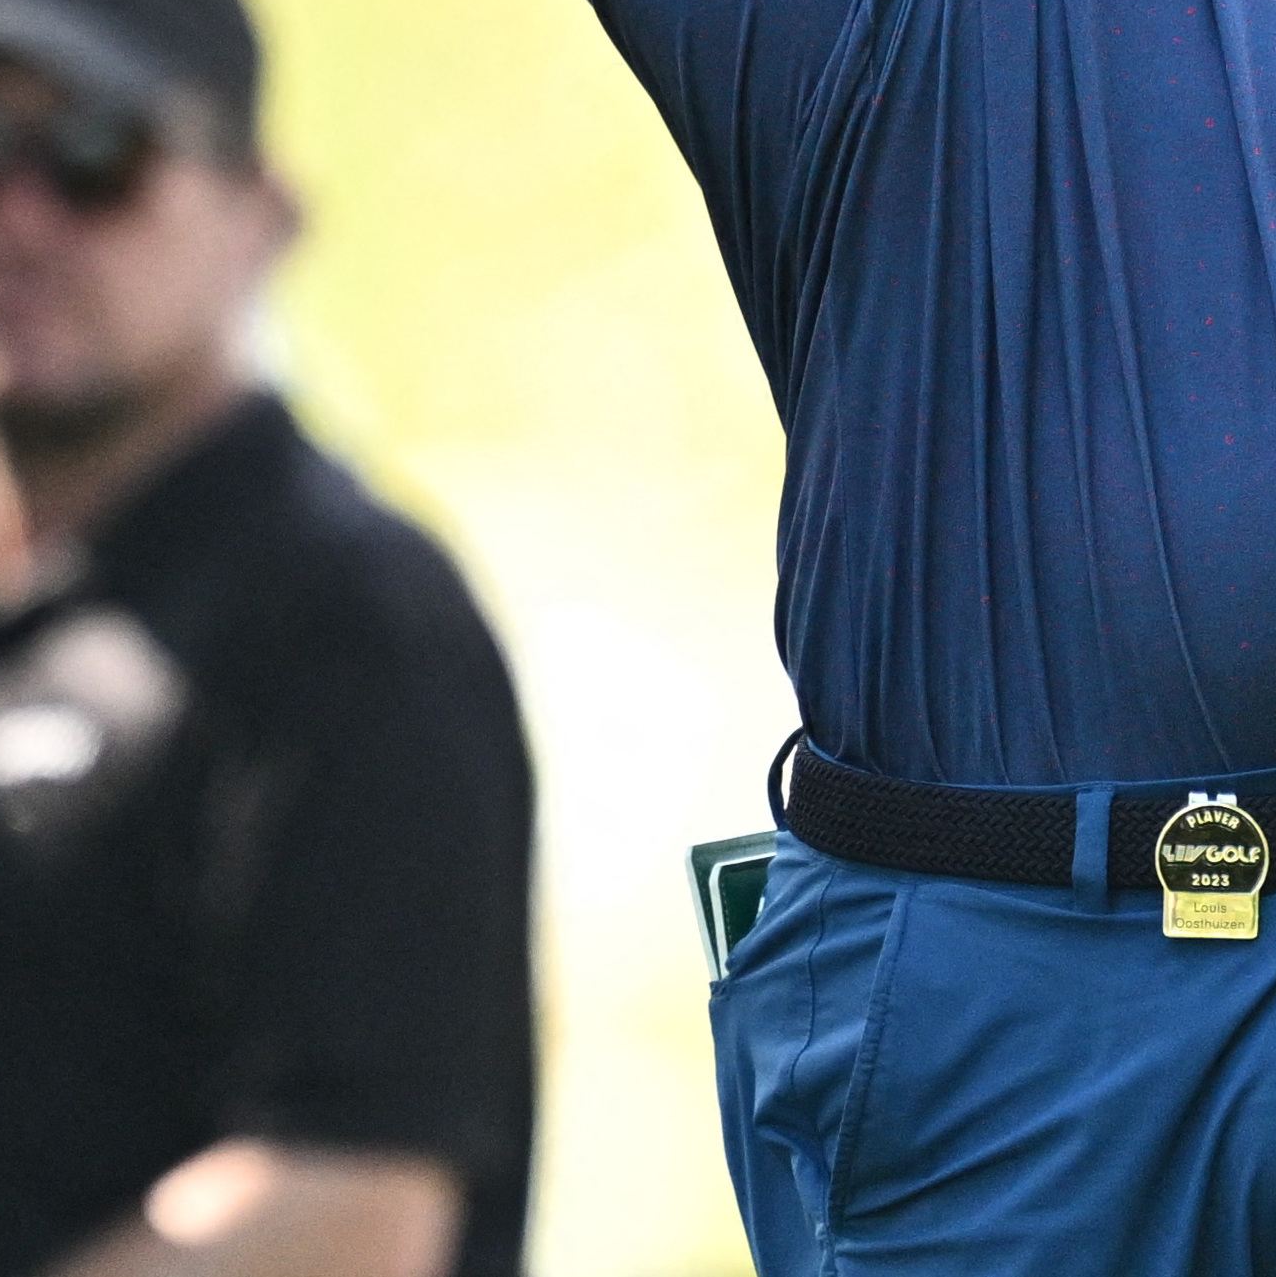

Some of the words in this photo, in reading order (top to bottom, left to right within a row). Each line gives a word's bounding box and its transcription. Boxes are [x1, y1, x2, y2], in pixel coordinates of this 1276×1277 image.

[1186, 810, 1240, 829] PLAYER
[1191, 874, 1230, 887] 2023
[1194, 902, 1227, 913] Louis
[1175, 917, 1245, 930] Oosthuizen
